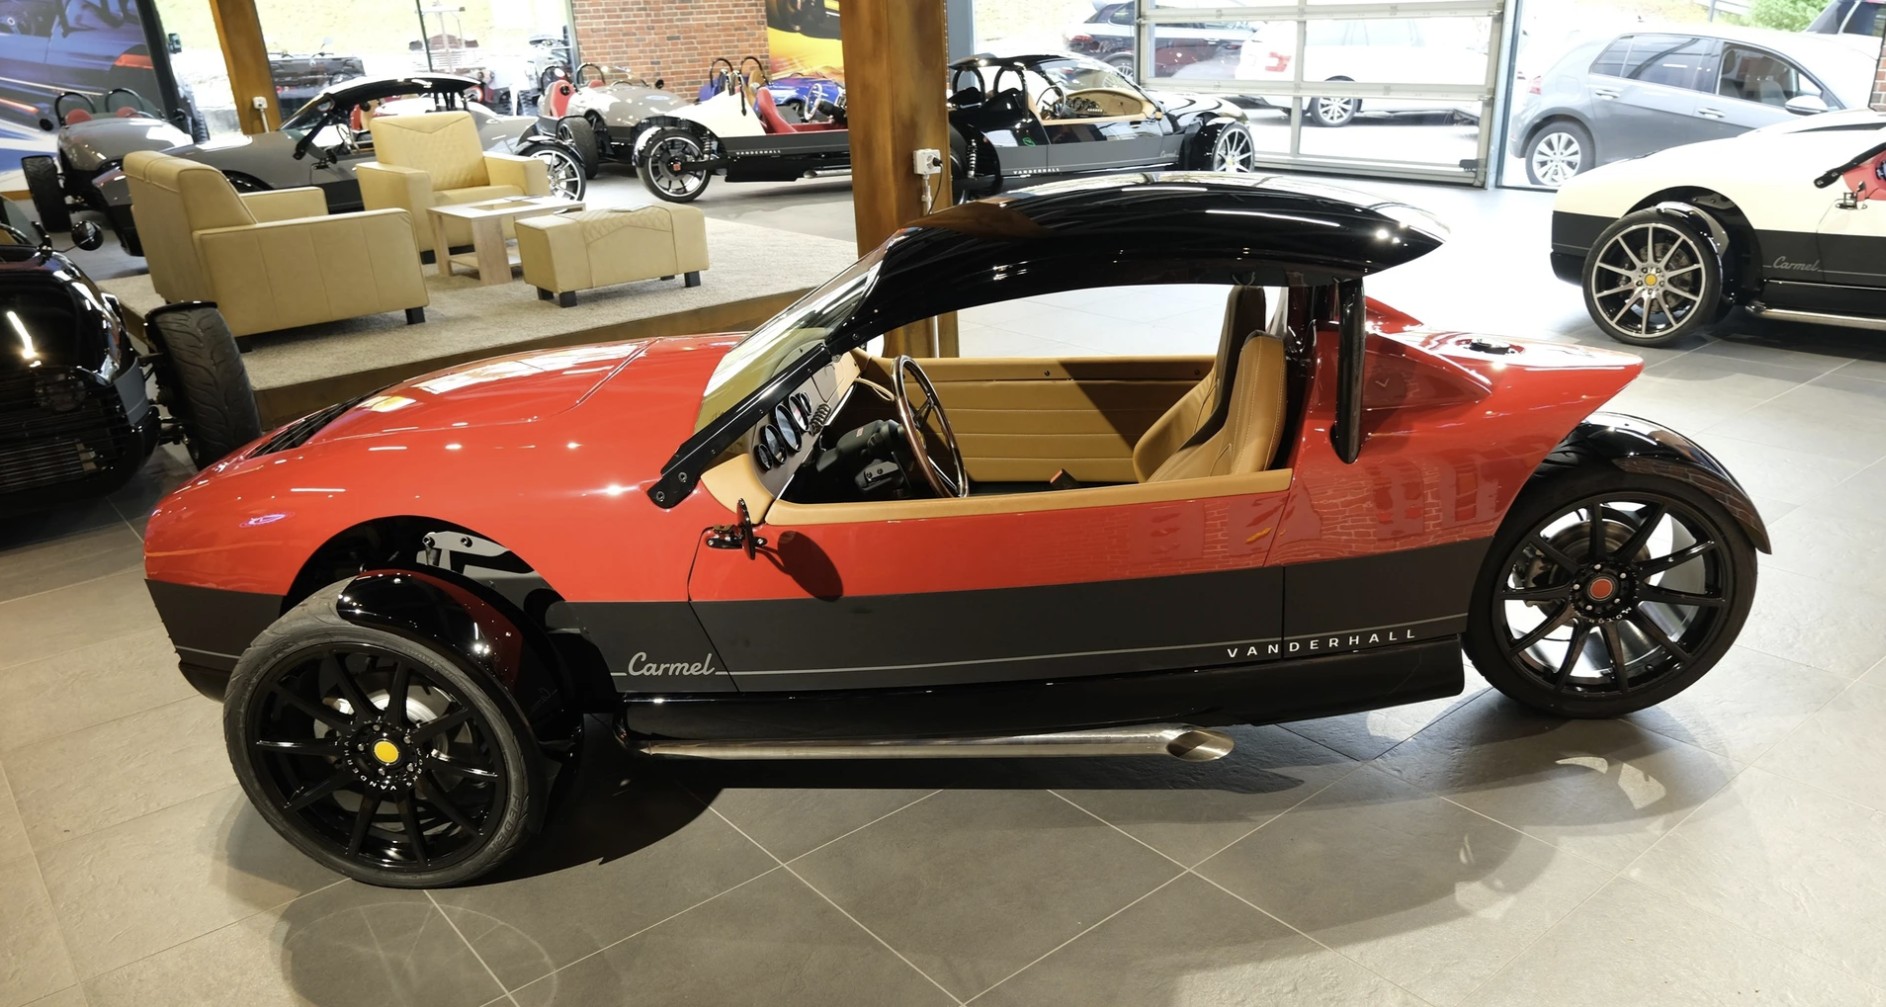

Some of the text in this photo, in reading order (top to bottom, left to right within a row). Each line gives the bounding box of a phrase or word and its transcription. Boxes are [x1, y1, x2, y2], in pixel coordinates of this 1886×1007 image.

[1773, 256, 1820, 271] Carmel
[1227, 629, 1416, 658] VANDERHALL
[628, 651, 715, 676] Carmel
